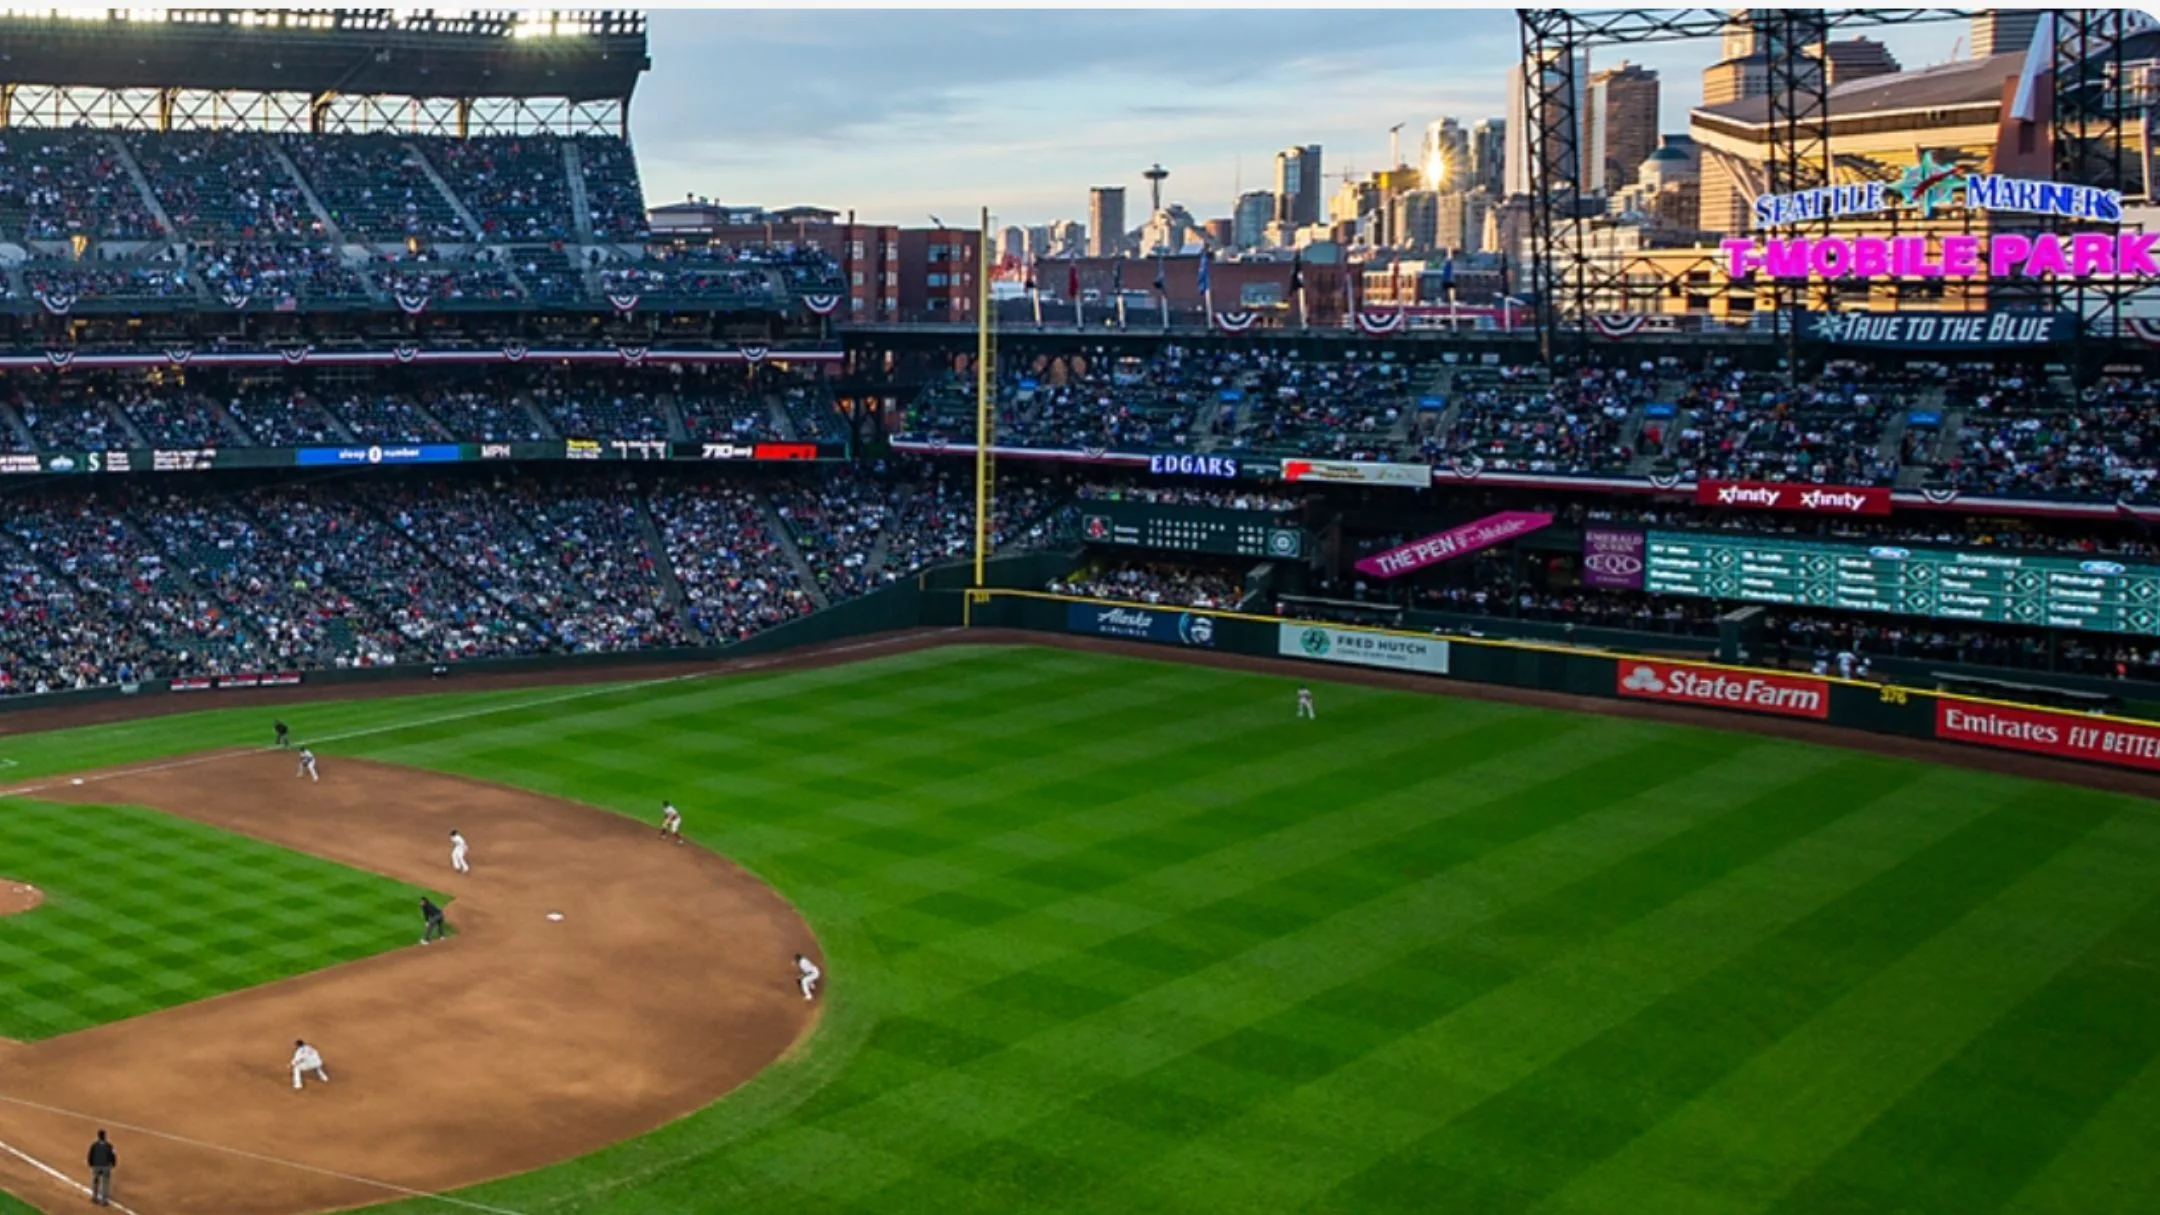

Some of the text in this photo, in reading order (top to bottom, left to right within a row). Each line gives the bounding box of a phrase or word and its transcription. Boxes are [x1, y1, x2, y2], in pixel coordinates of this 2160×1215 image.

[1755, 173, 2121, 228] SEATTLE MARINERS
[1720, 232, 2160, 279] T-MOBILE PARK
[1150, 454, 1237, 477] EDGARS
[1717, 484, 1866, 511] xfinity xfinity
[1376, 548, 1416, 574] THE
[1416, 536, 1456, 561] PEN
[1098, 608, 1153, 627] Alaska
[1337, 635, 1374, 649] FRED
[1378, 640, 1428, 655] HUTCH
[1945, 708, 2058, 743] Emirates
[2068, 726, 2098, 749] FLY
